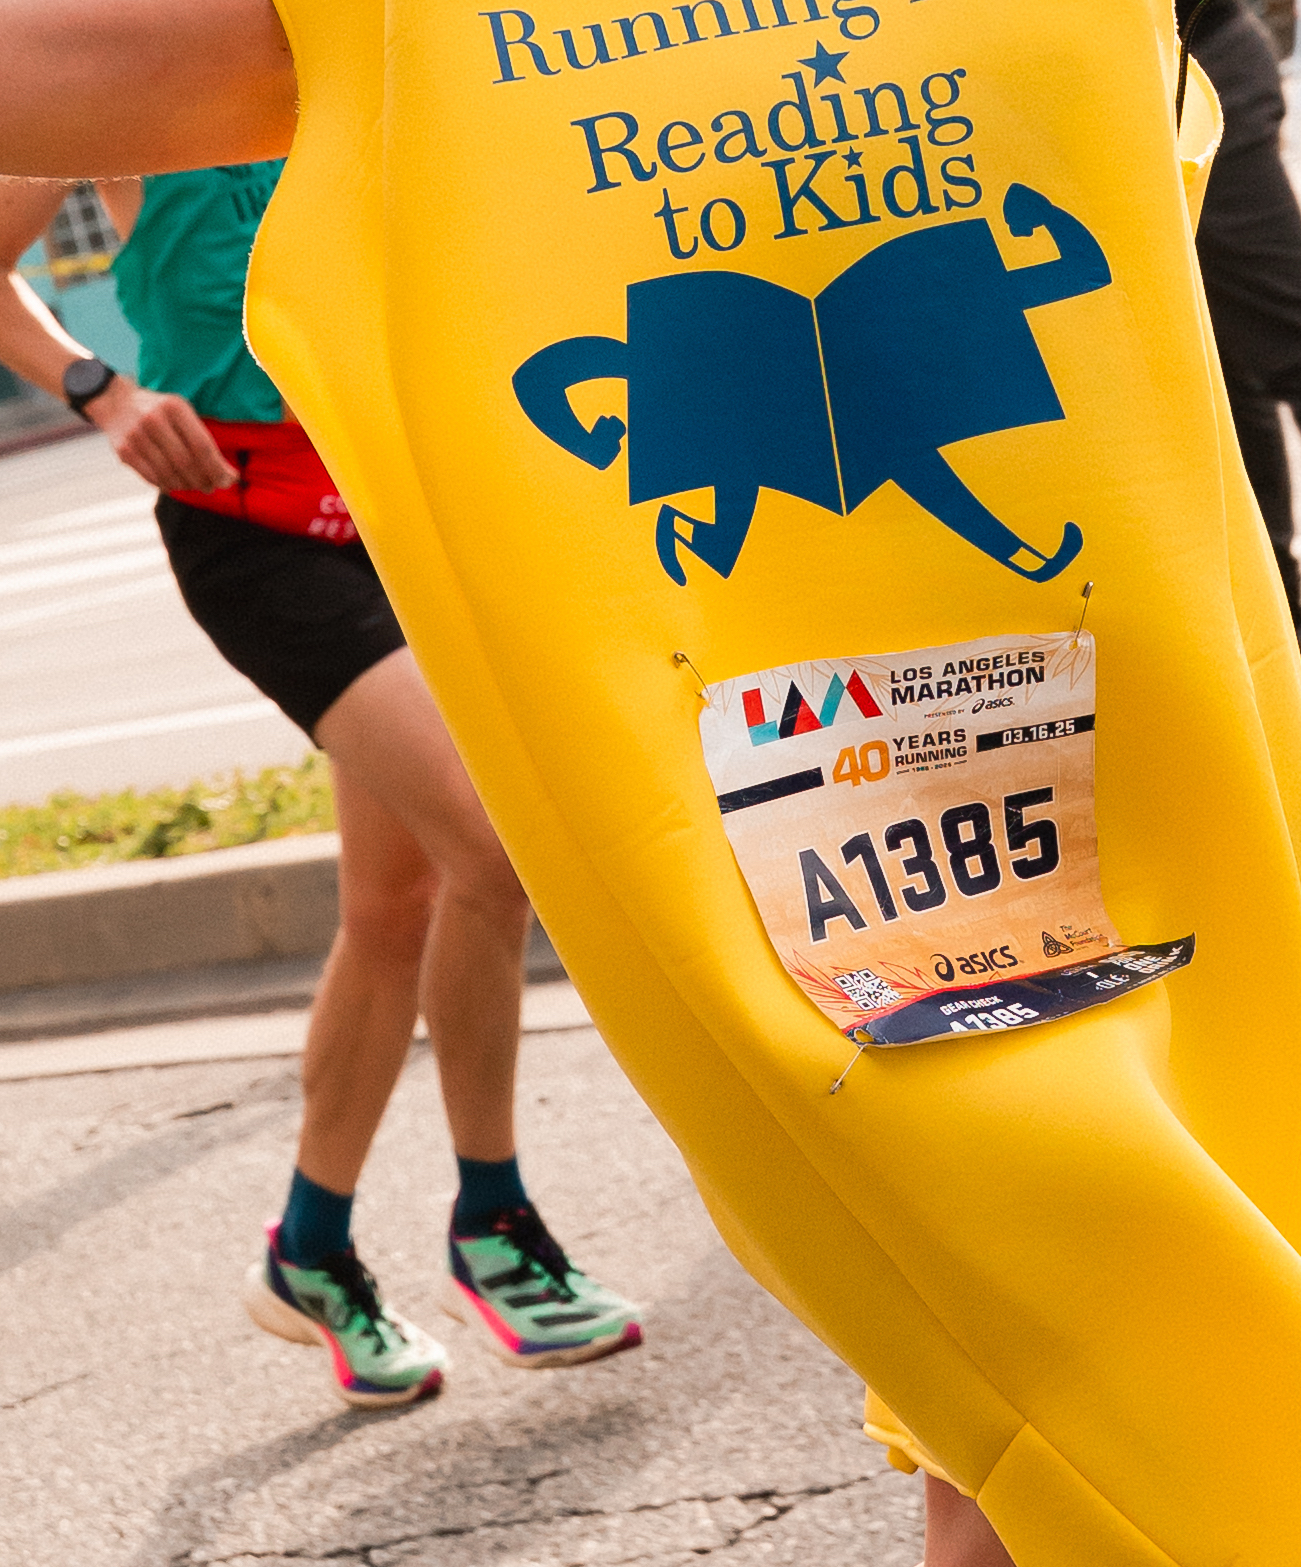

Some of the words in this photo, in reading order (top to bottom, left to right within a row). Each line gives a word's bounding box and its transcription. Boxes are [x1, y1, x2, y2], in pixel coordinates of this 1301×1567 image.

[570, 40, 974, 194] Reading
[654, 187, 747, 260] to
[762, 134, 983, 240] Kids
[890, 666, 932, 684] LOS
[942, 651, 1045, 676] ANGELES
[890, 665, 1045, 706] MARATHON
[924, 709, 956, 718] PRESENTED
[1002, 719, 1076, 745] 03.16.25
[832, 739, 891, 787] 40
[892, 728, 967, 752] YEARS
[894, 746, 967, 768] RUNNING
[798, 785, 1061, 945] A1385
[1123, 955, 1162, 971] ONE
[939, 998, 970, 1016] GEAR
[967, 995, 1004, 1010] CHECK
[949, 1002, 1040, 1033] A1385
